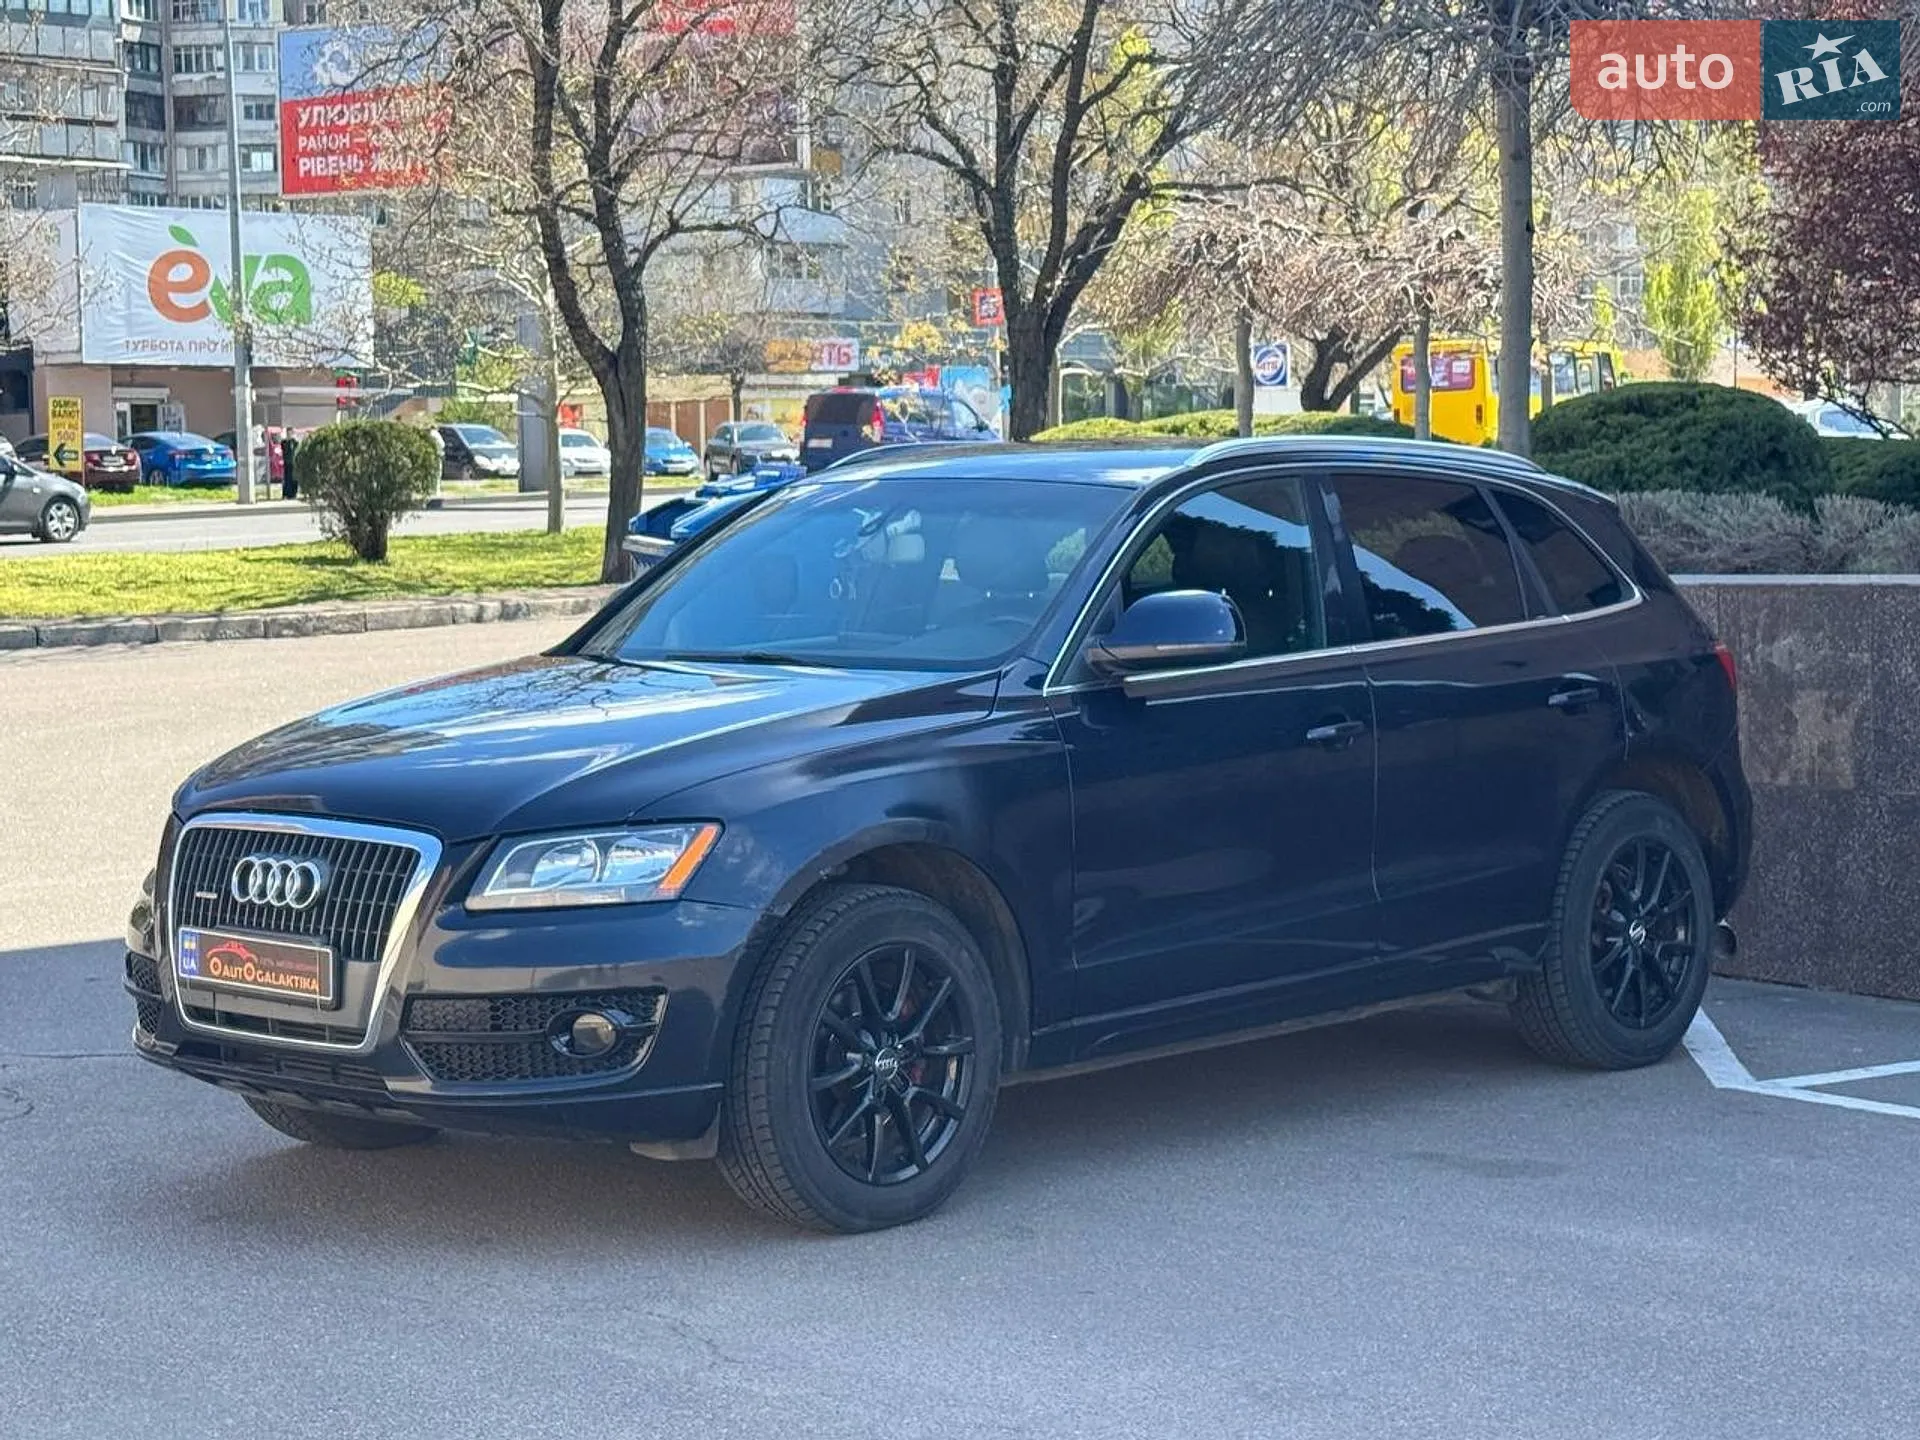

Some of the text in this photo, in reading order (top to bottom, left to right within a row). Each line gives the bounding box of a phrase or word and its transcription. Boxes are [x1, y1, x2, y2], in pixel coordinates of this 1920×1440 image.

[298, 130, 350, 151] РАЙОН
[298, 153, 364, 178] РІВЕНЬ
[125, 339, 184, 353] ТУРБОТА
[182, 957, 197, 970] UA
